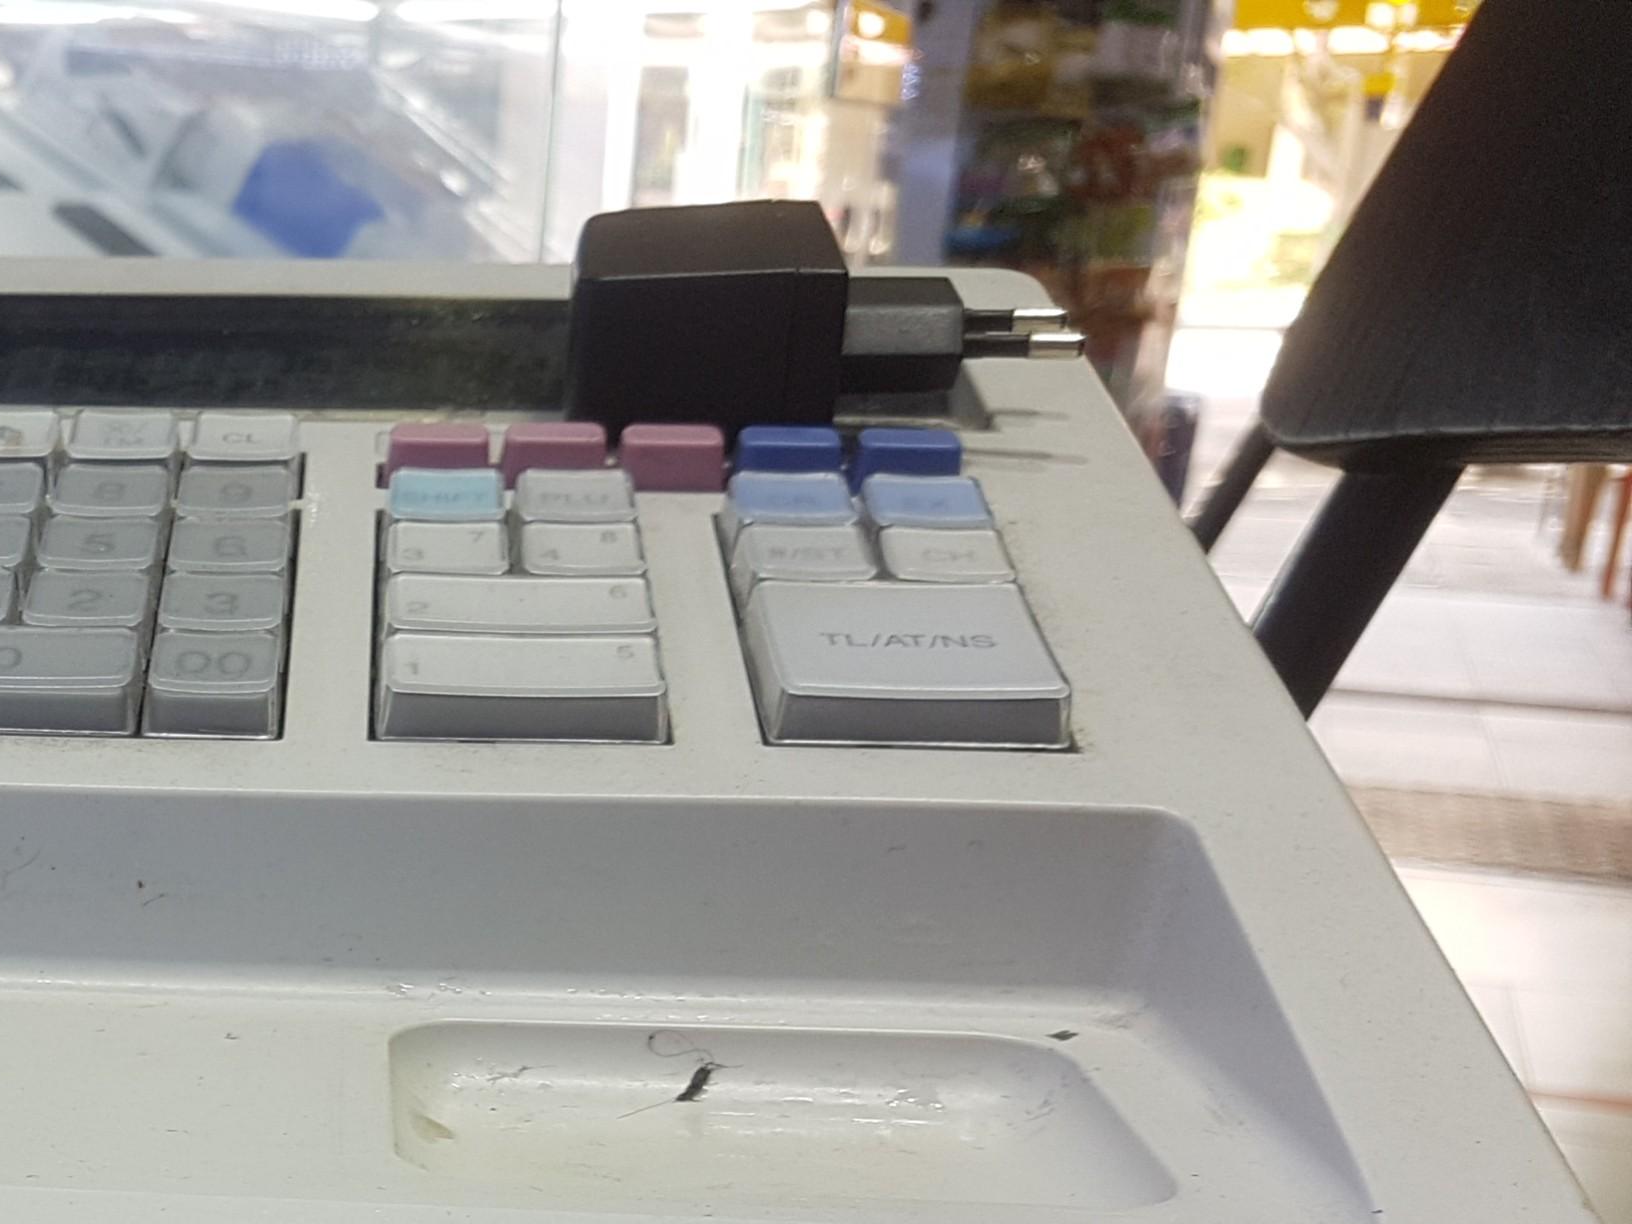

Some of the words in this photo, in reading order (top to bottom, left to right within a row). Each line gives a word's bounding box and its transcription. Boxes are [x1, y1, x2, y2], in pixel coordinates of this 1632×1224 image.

[222, 432, 260, 445] CL
[83, 532, 116, 553] 5
[213, 536, 247, 557] 6
[68, 589, 103, 611] 2
[203, 592, 240, 614] 3
[819, 631, 999, 650] TL/AT/NS
